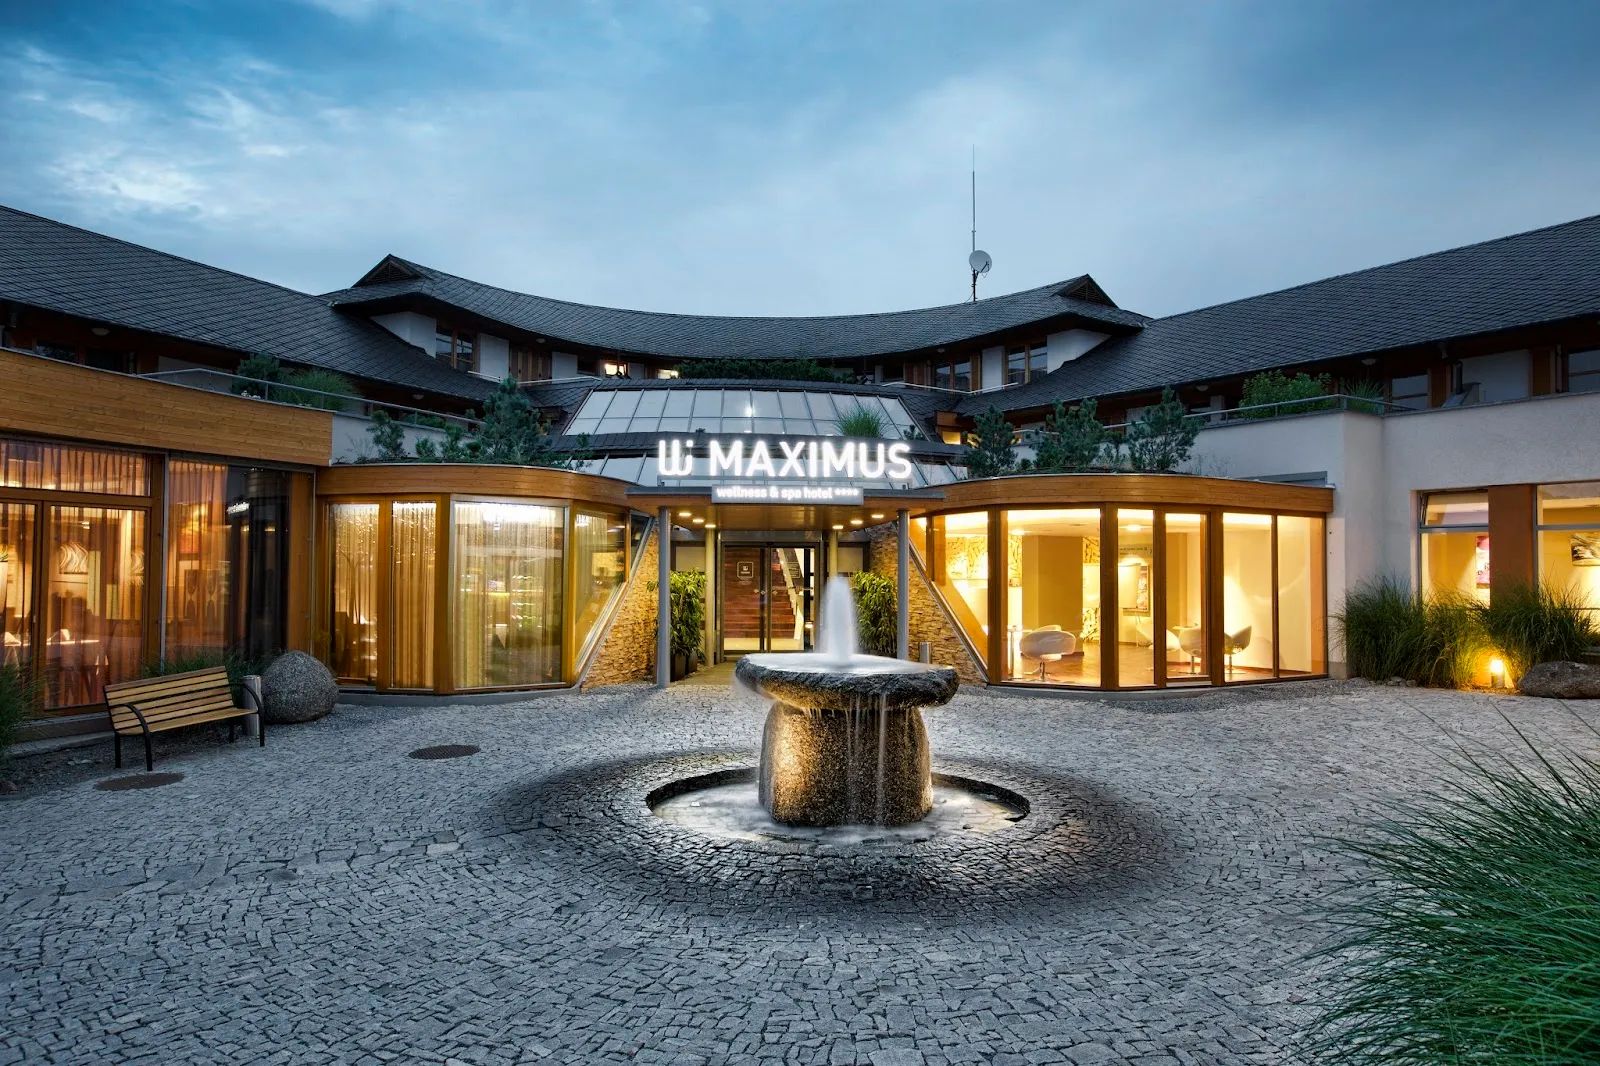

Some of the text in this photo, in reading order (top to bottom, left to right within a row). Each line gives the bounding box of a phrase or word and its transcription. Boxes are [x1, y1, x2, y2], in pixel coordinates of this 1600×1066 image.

[709, 439, 912, 479] MAXIMUS
[716, 486, 833, 500] wellness & spa hotel
